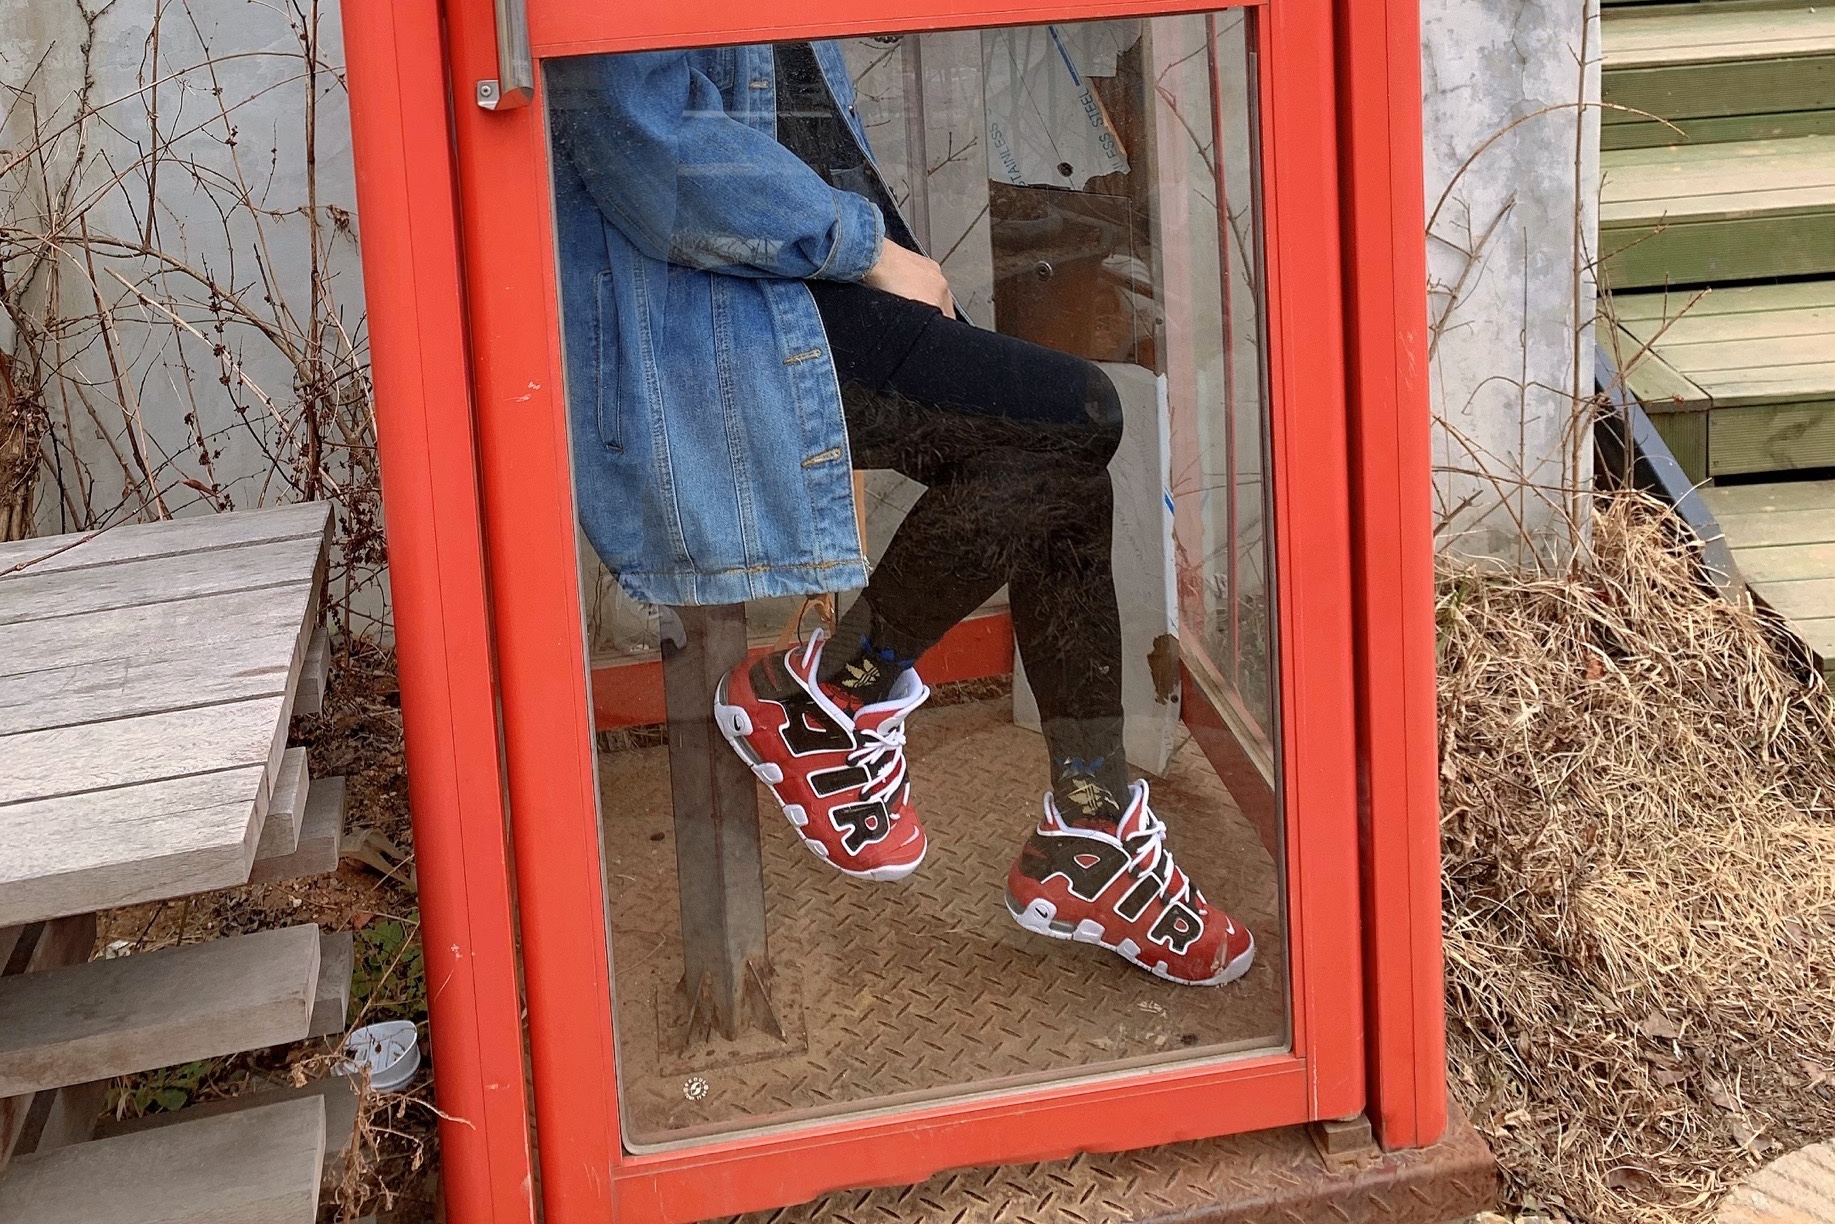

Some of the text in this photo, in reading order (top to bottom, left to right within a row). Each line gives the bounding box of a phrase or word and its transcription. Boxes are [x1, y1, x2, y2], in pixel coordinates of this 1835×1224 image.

[1079, 88, 1104, 128] STEEL
[752, 674, 891, 857] AIR
[1022, 836, 1204, 956] AIR
